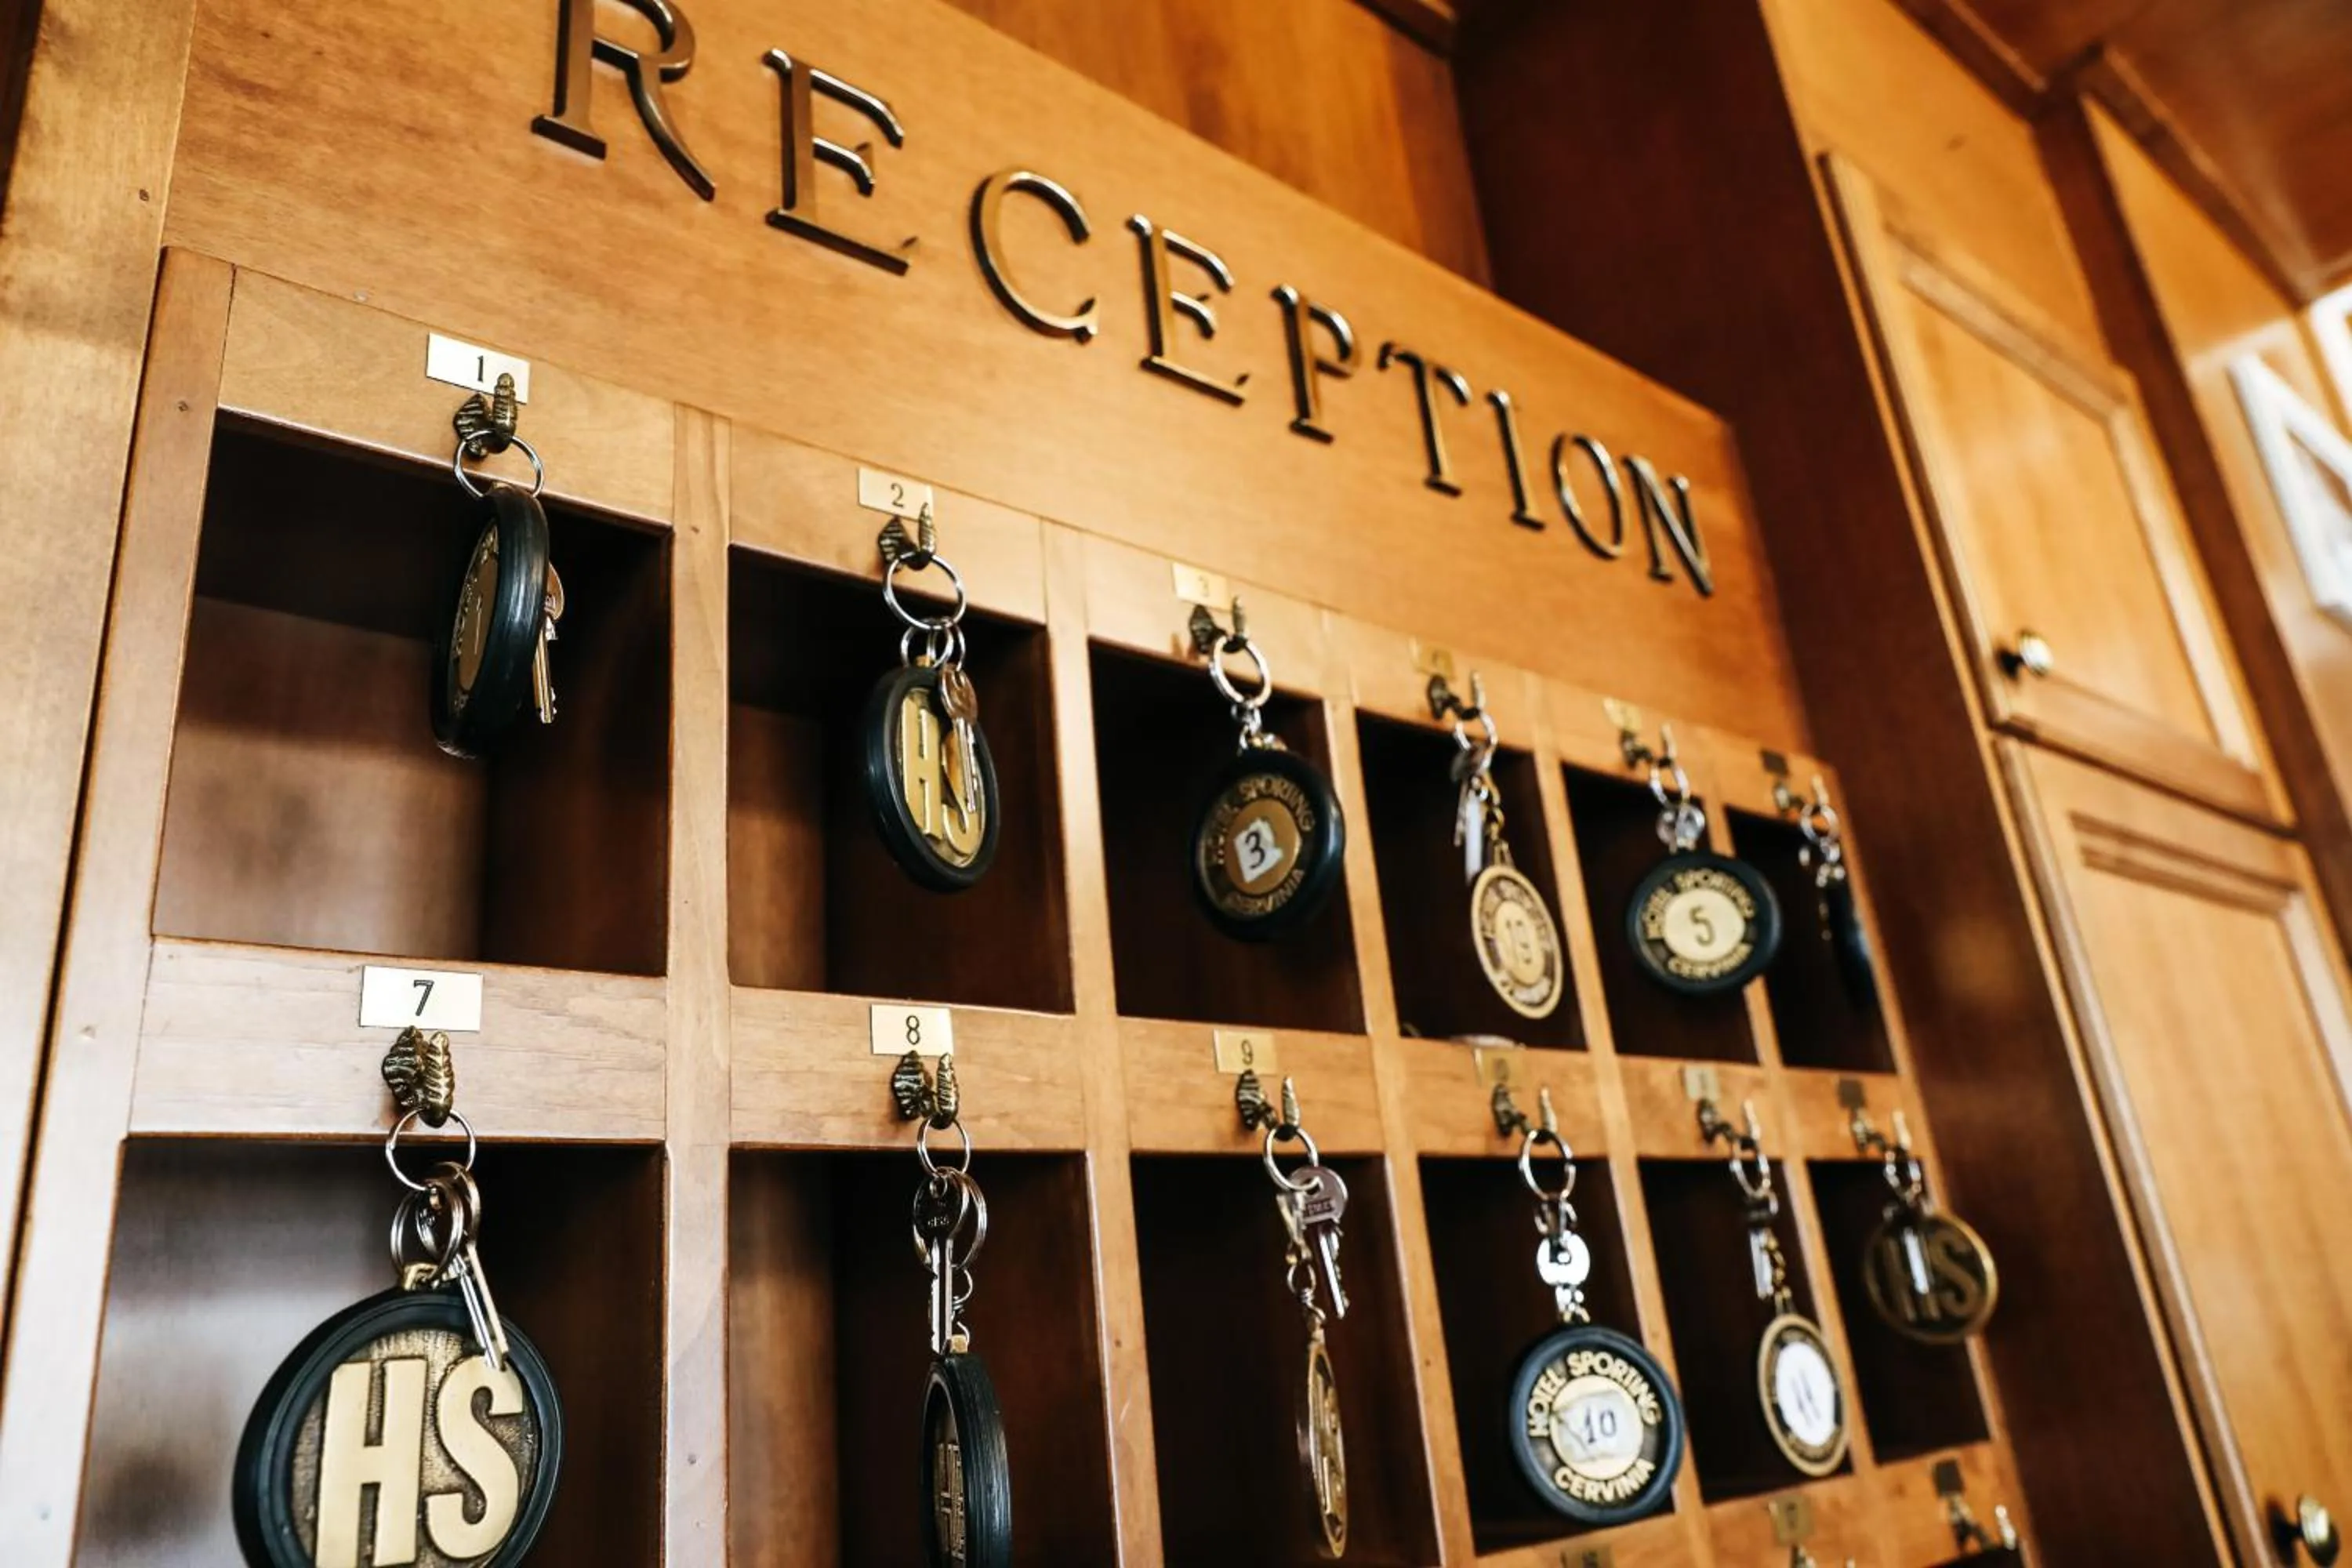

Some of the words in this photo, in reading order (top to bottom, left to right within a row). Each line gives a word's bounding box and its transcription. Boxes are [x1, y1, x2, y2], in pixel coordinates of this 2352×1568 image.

[531, 0, 1712, 597] RECEPTION
[477, 355, 484, 383] 1
[891, 483, 904, 508] 2
[1199, 575, 1210, 597] 3
[1244, 831, 1265, 869] 3
[1689, 905, 1715, 946] 5
[413, 979, 434, 1017] 7
[906, 1014, 920, 1044] 8
[1241, 1040, 1253, 1065] 9
[1527, 1367, 1566, 1437] HOTEL
[1566, 1350, 1663, 1425] SPORTING
[1584, 1406, 1617, 1443] 10
[316, 1355, 524, 1568] HS
[1554, 1457, 1656, 1502] CERVINIA
